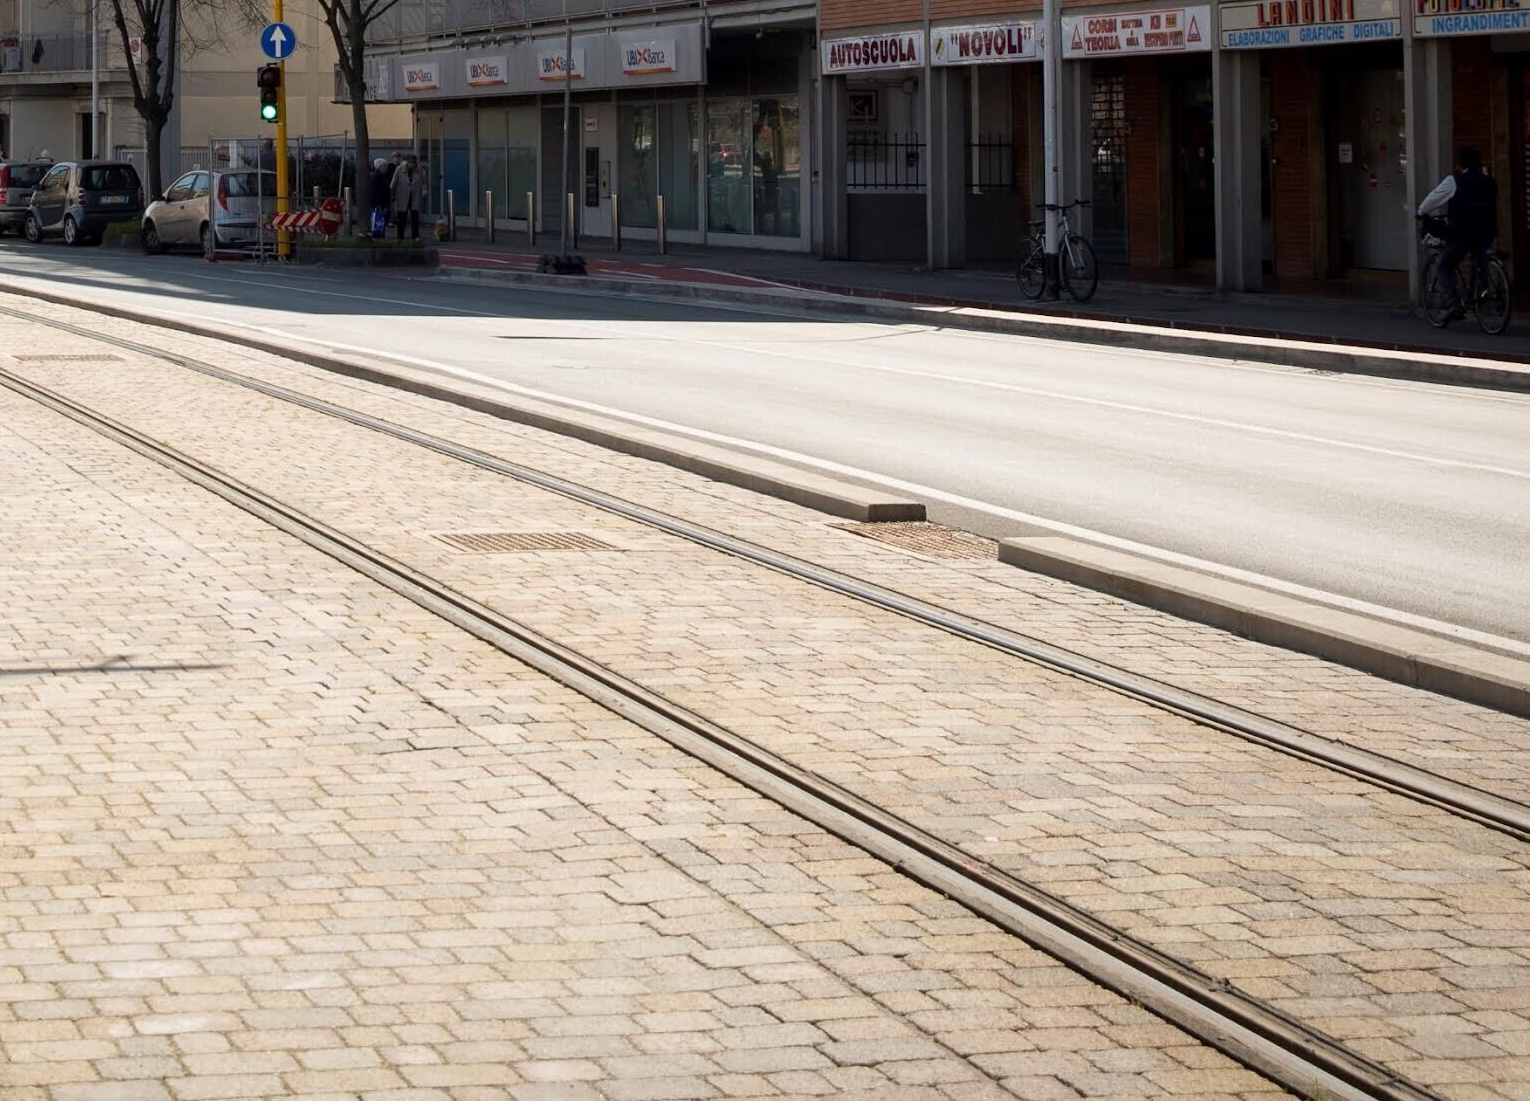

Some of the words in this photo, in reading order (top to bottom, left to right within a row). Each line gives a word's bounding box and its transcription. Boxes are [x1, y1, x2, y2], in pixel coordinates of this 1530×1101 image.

[1085, 35, 1120, 51] TEORIA
[1228, 29, 1290, 47] ELABORAZIONI
[1299, 25, 1345, 42] GRAFICHE
[1353, 21, 1394, 39] DIGITALI
[829, 37, 916, 67] AUTOSCUOLA
